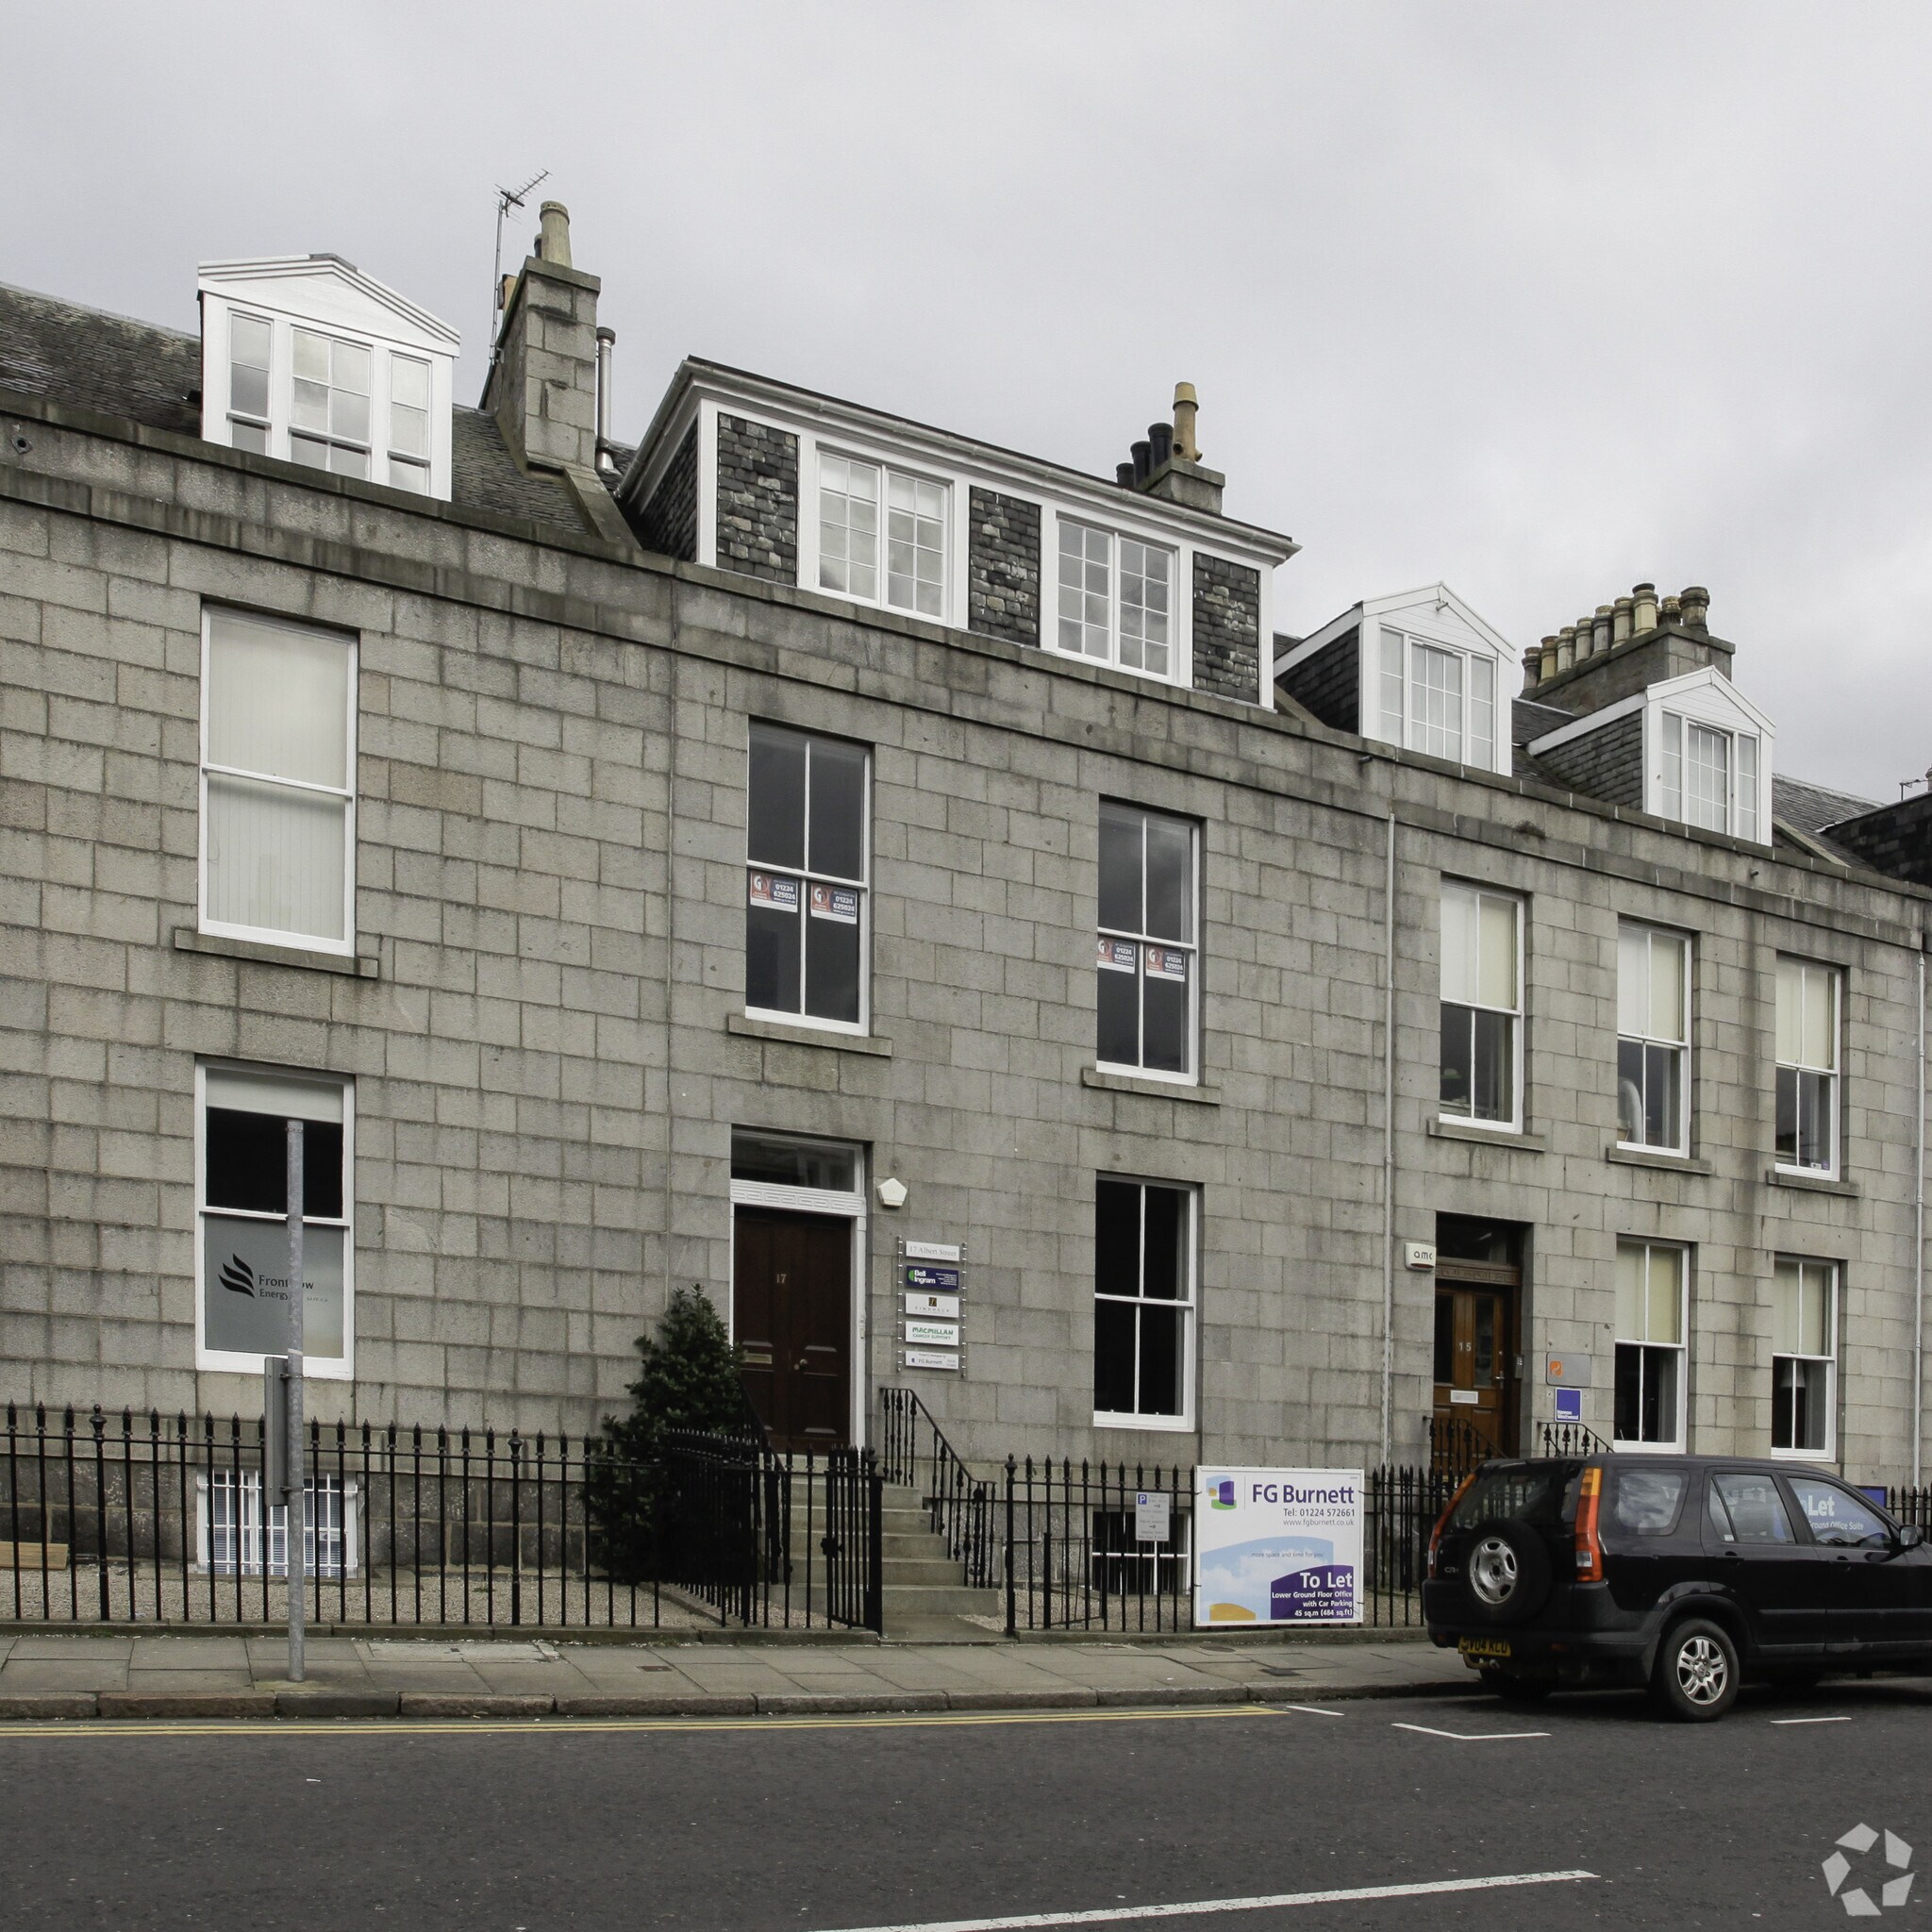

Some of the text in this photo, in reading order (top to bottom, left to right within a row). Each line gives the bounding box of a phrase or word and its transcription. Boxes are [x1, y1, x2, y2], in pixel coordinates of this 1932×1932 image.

[775, 884, 794, 892] 01224
[773, 891, 796, 900] 625024
[835, 896, 853, 904] 01224
[833, 903, 855, 912] 625024
[776, 1274, 787, 1284] 17
[260, 1289, 288, 1300] Energy
[1459, 1343, 1471, 1351] 15
[1253, 1484, 1354, 1504] FG Burnett
[1808, 1495, 1834, 1516] Let
[1300, 1508, 1324, 1517] 01224
[1327, 1508, 1355, 1517] 572661
[1283, 1519, 1354, 1527] www.fgburnett.co.uk
[1849, 1522, 1864, 1530] Suite
[1300, 1572, 1352, 1588] To Let
[1336, 1609, 1352, 1617] sq.ft)
